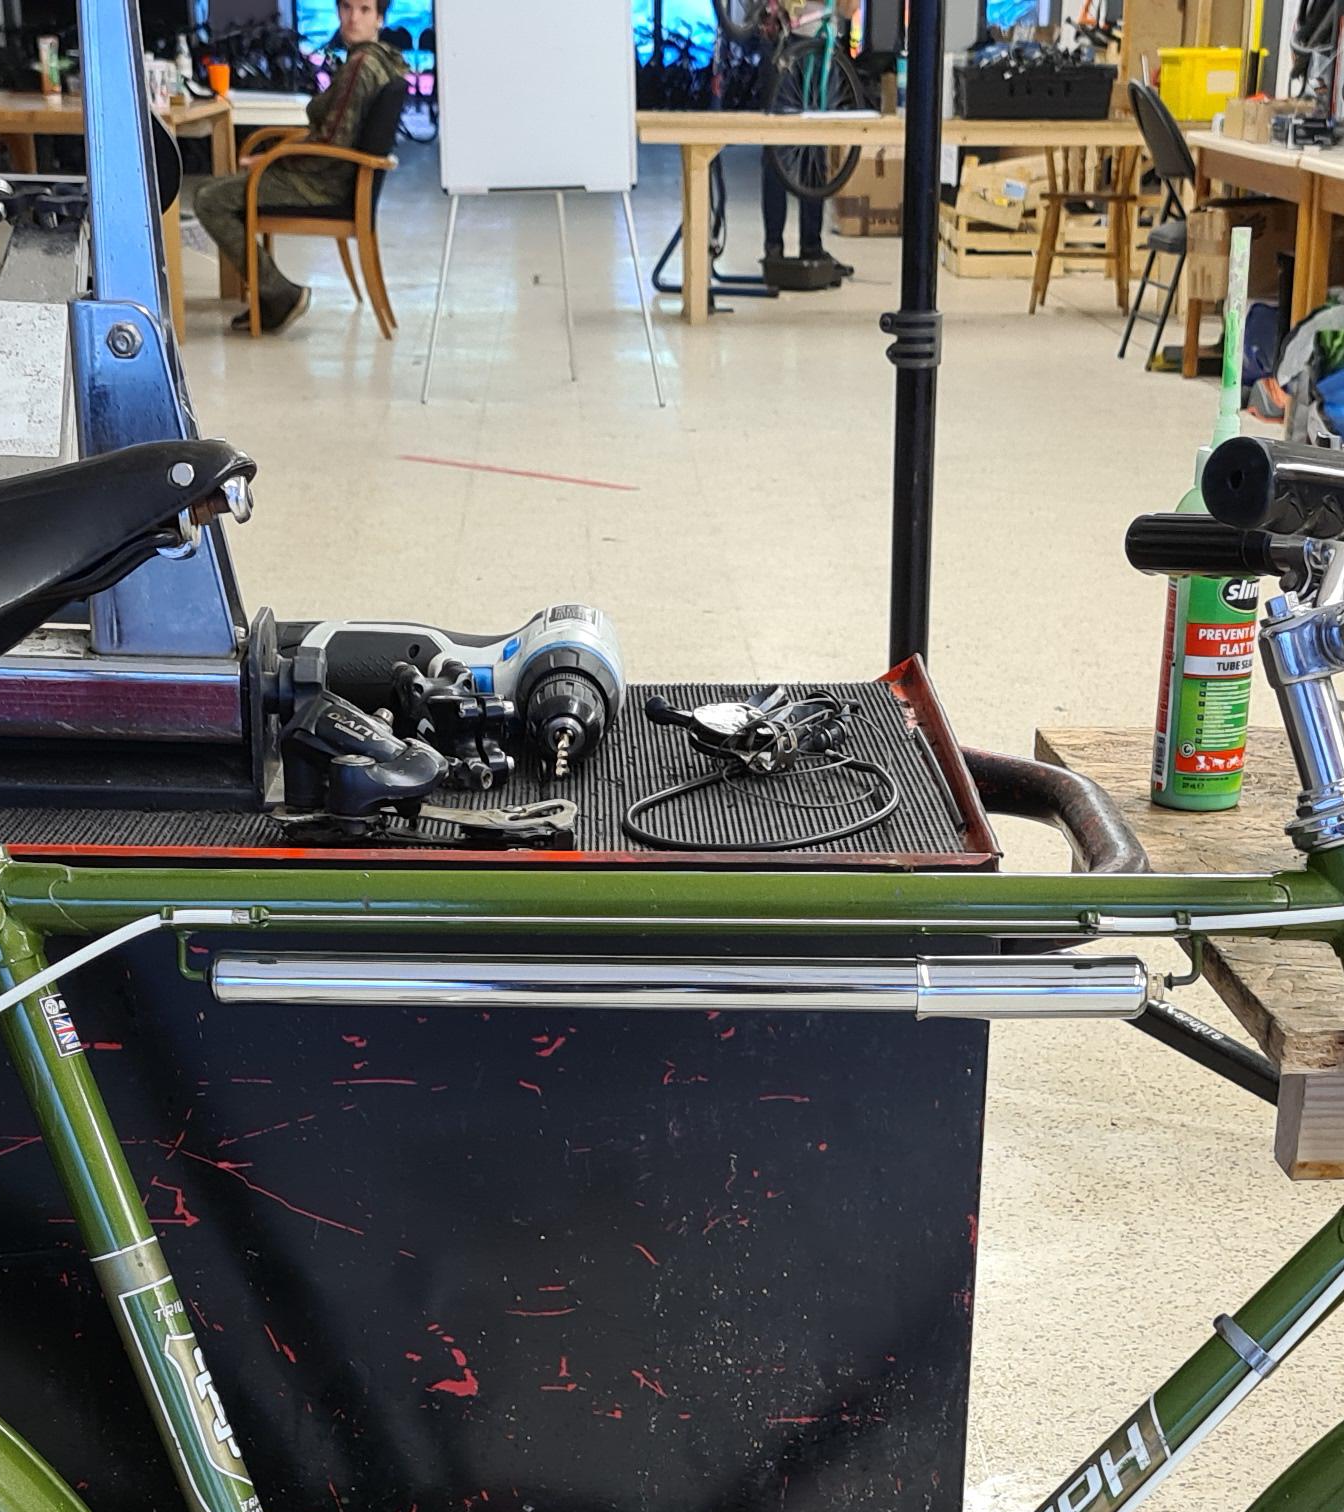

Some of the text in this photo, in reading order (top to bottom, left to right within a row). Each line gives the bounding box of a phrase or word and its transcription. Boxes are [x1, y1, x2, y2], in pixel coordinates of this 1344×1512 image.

[1198, 627, 1250, 640] PREVENT
[1219, 642, 1244, 655] FLAT
[1217, 661, 1240, 671] TUBE
